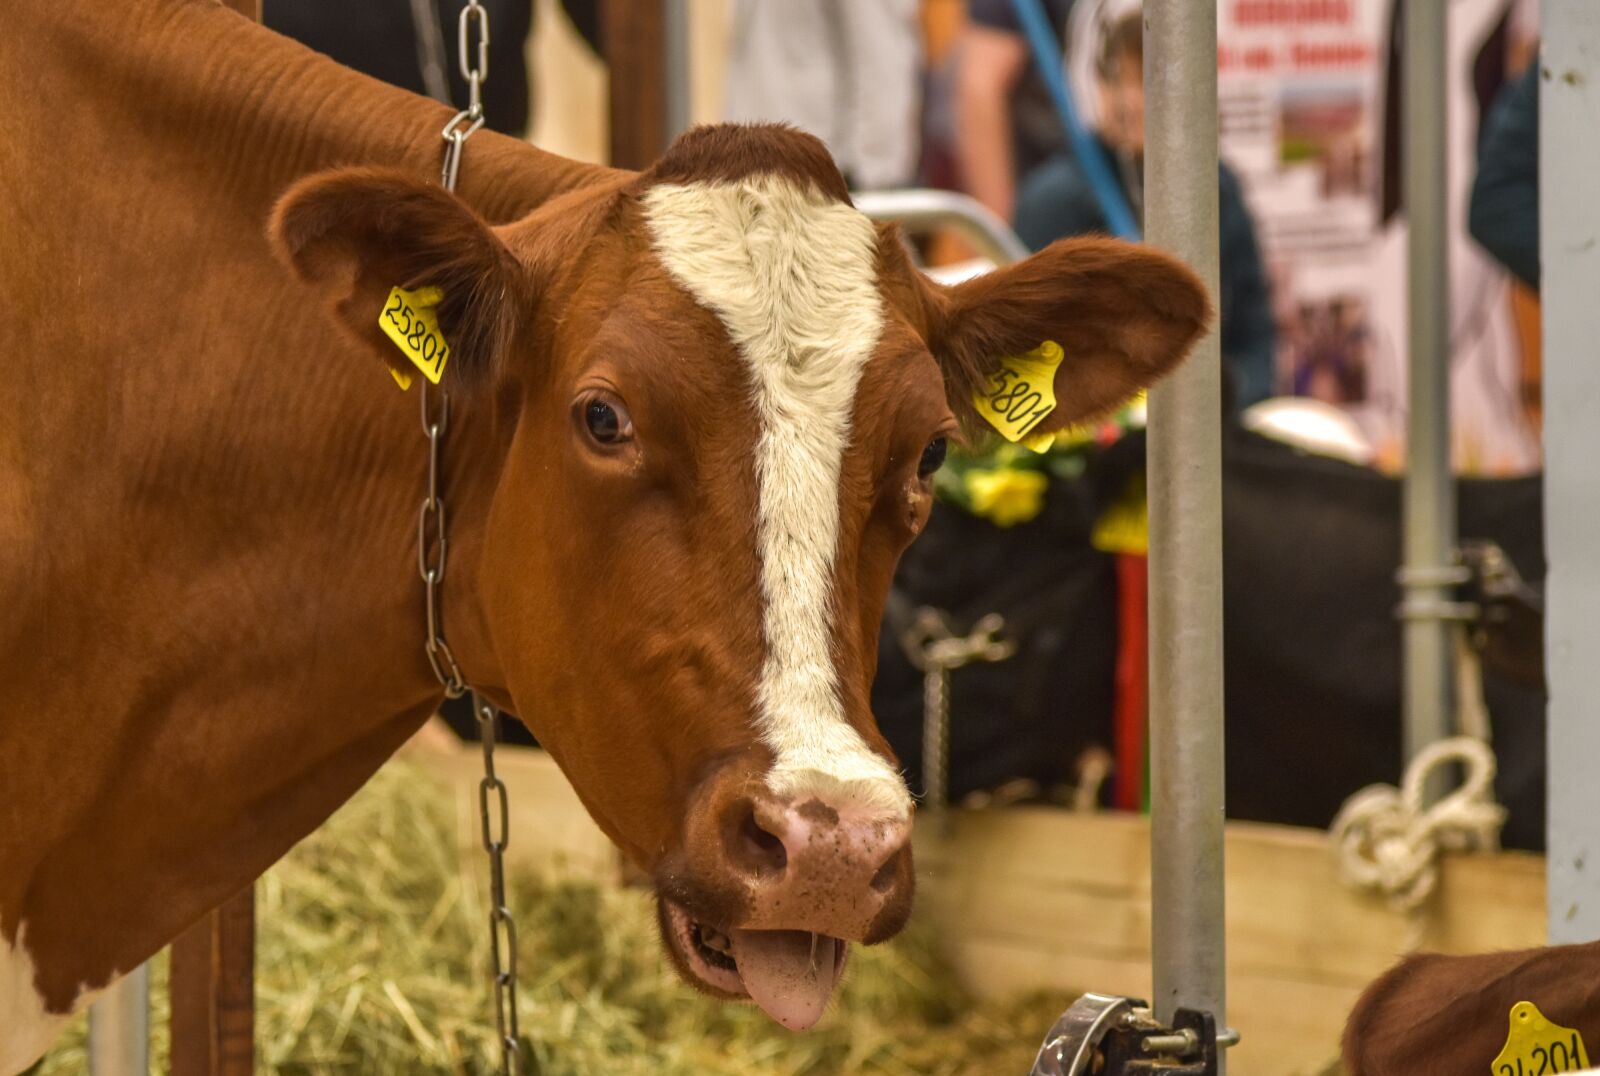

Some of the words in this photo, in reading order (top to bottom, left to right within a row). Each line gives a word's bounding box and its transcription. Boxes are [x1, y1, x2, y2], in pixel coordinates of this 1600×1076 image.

[385, 294, 447, 374] 25801
[980, 368, 1053, 434] 5801
[1499, 1033, 1582, 1076] 201
